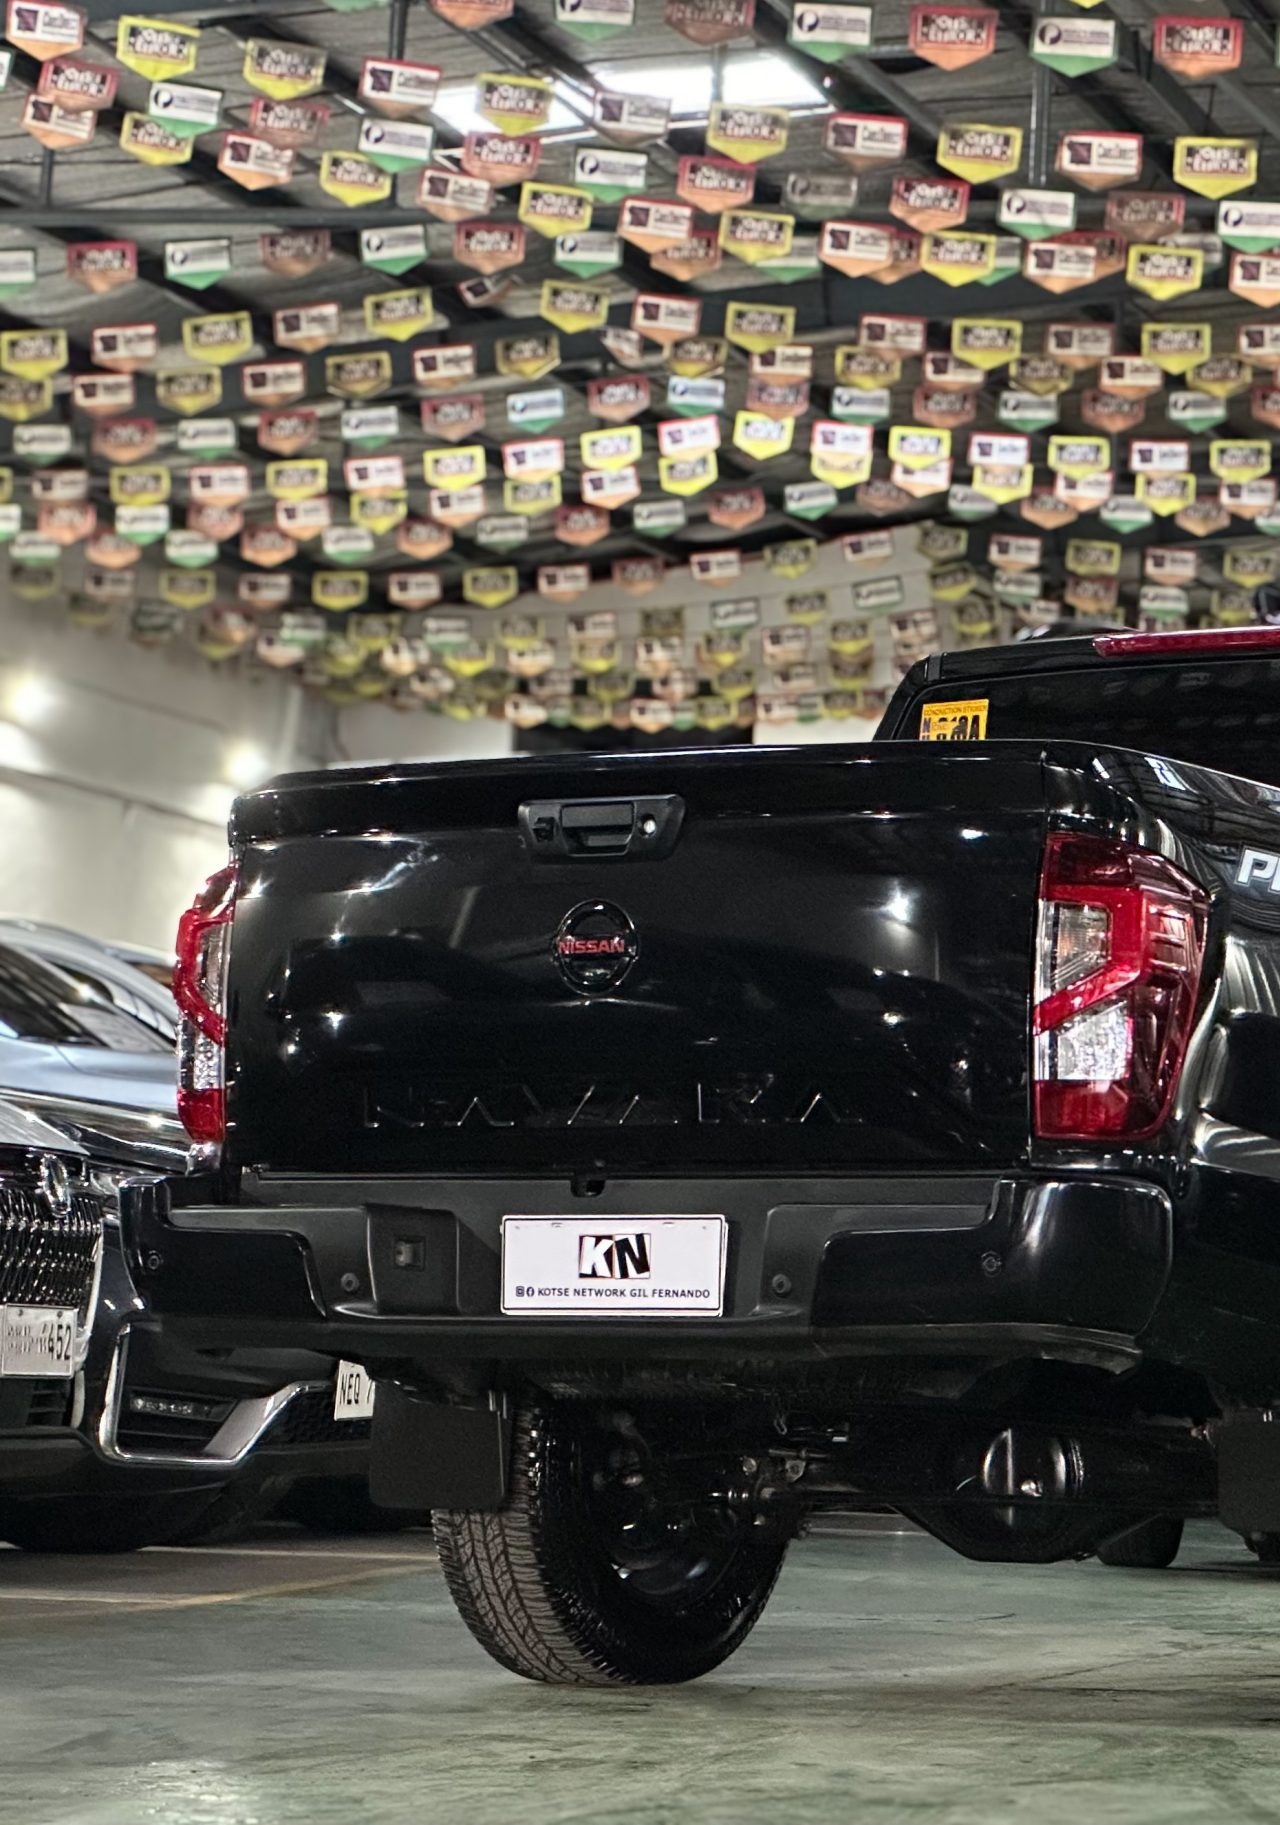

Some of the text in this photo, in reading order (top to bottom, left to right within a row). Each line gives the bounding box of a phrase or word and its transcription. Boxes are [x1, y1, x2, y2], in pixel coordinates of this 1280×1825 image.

[559, 938, 625, 954] NISSAN
[579, 1234, 651, 1279] KN
[538, 1287, 711, 1299] KOTSE NETWORK GIL FERNANDO
